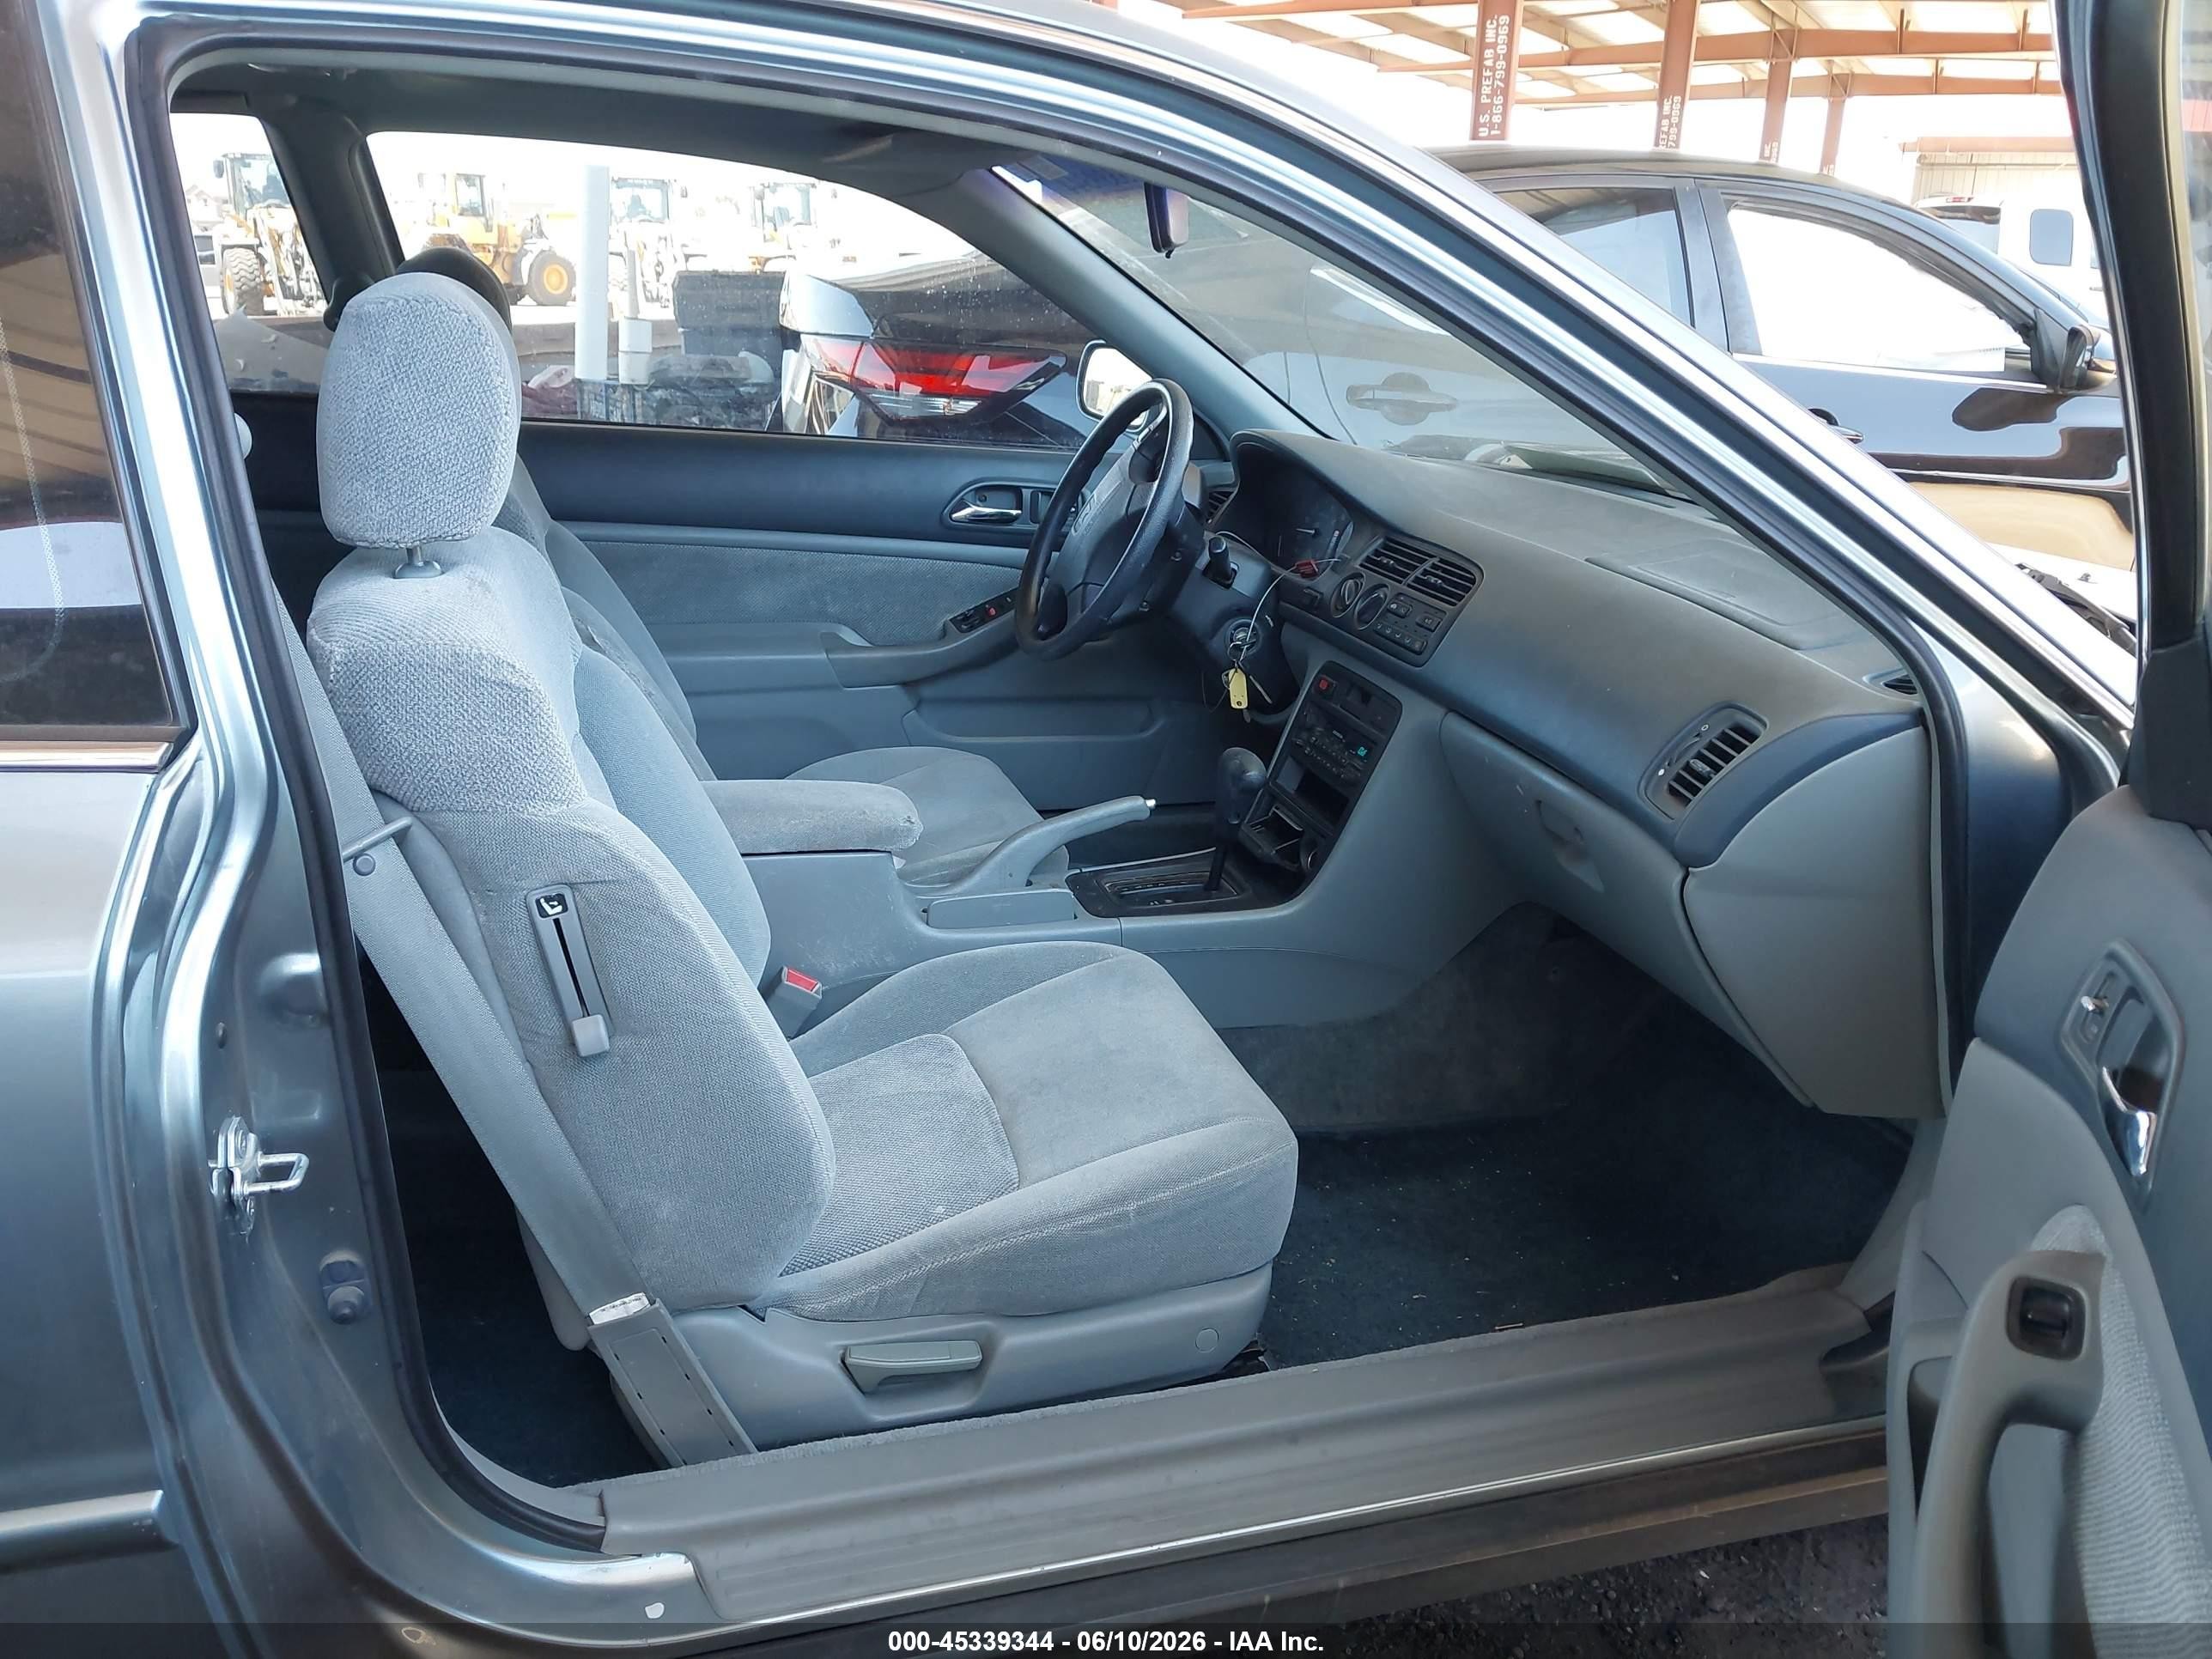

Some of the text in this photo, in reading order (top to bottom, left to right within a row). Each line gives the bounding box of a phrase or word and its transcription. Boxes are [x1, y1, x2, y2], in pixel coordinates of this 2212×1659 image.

[1479, 14, 1498, 137] U.S. PREFAB INC.
[1491, 15, 1510, 137] 1-866-799-0969
